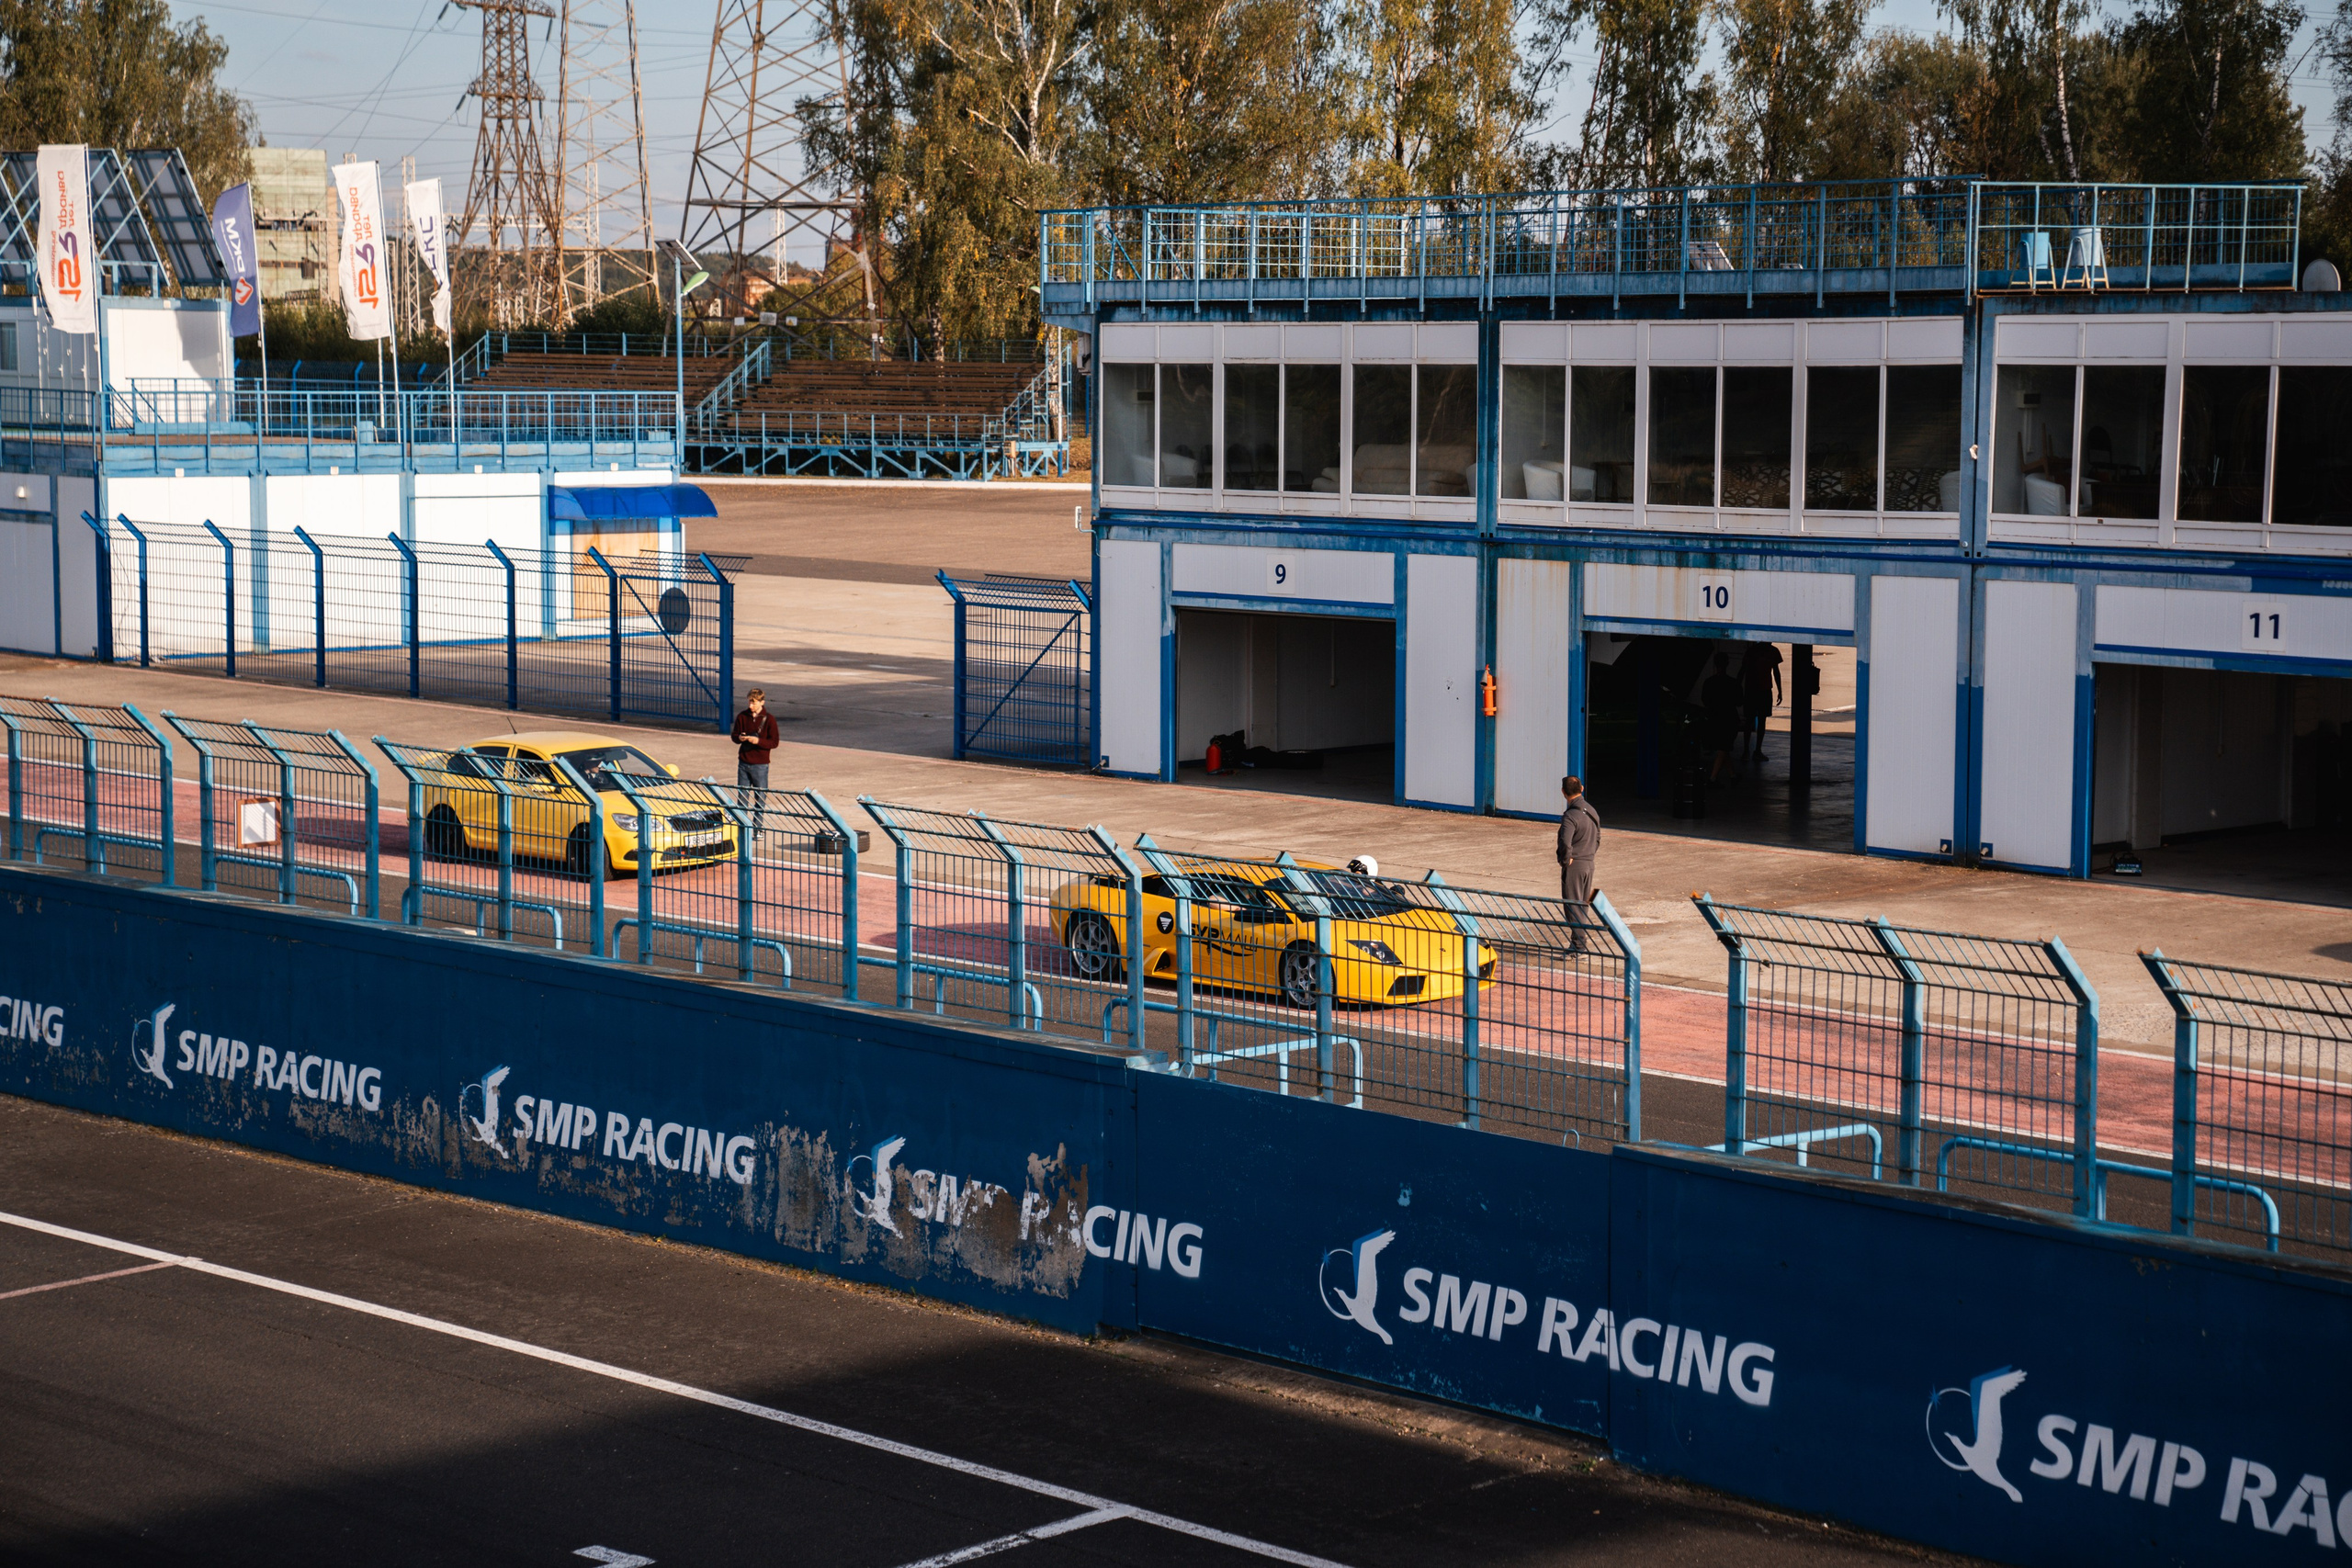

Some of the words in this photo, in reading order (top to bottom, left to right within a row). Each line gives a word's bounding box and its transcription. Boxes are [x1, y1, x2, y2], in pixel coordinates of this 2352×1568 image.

[1275, 563, 1286, 584] 9
[1702, 585, 1729, 609] 10
[2249, 612, 2279, 639] 11
[176, 1030, 249, 1080] SMP
[254, 1044, 382, 1111] RACING
[513, 1095, 597, 1150] SMP
[603, 1111, 755, 1185] RACING
[1398, 1267, 1528, 1342] SMP
[1537, 1296, 1776, 1407] RACING
[2030, 1414, 2207, 1507] SMP
